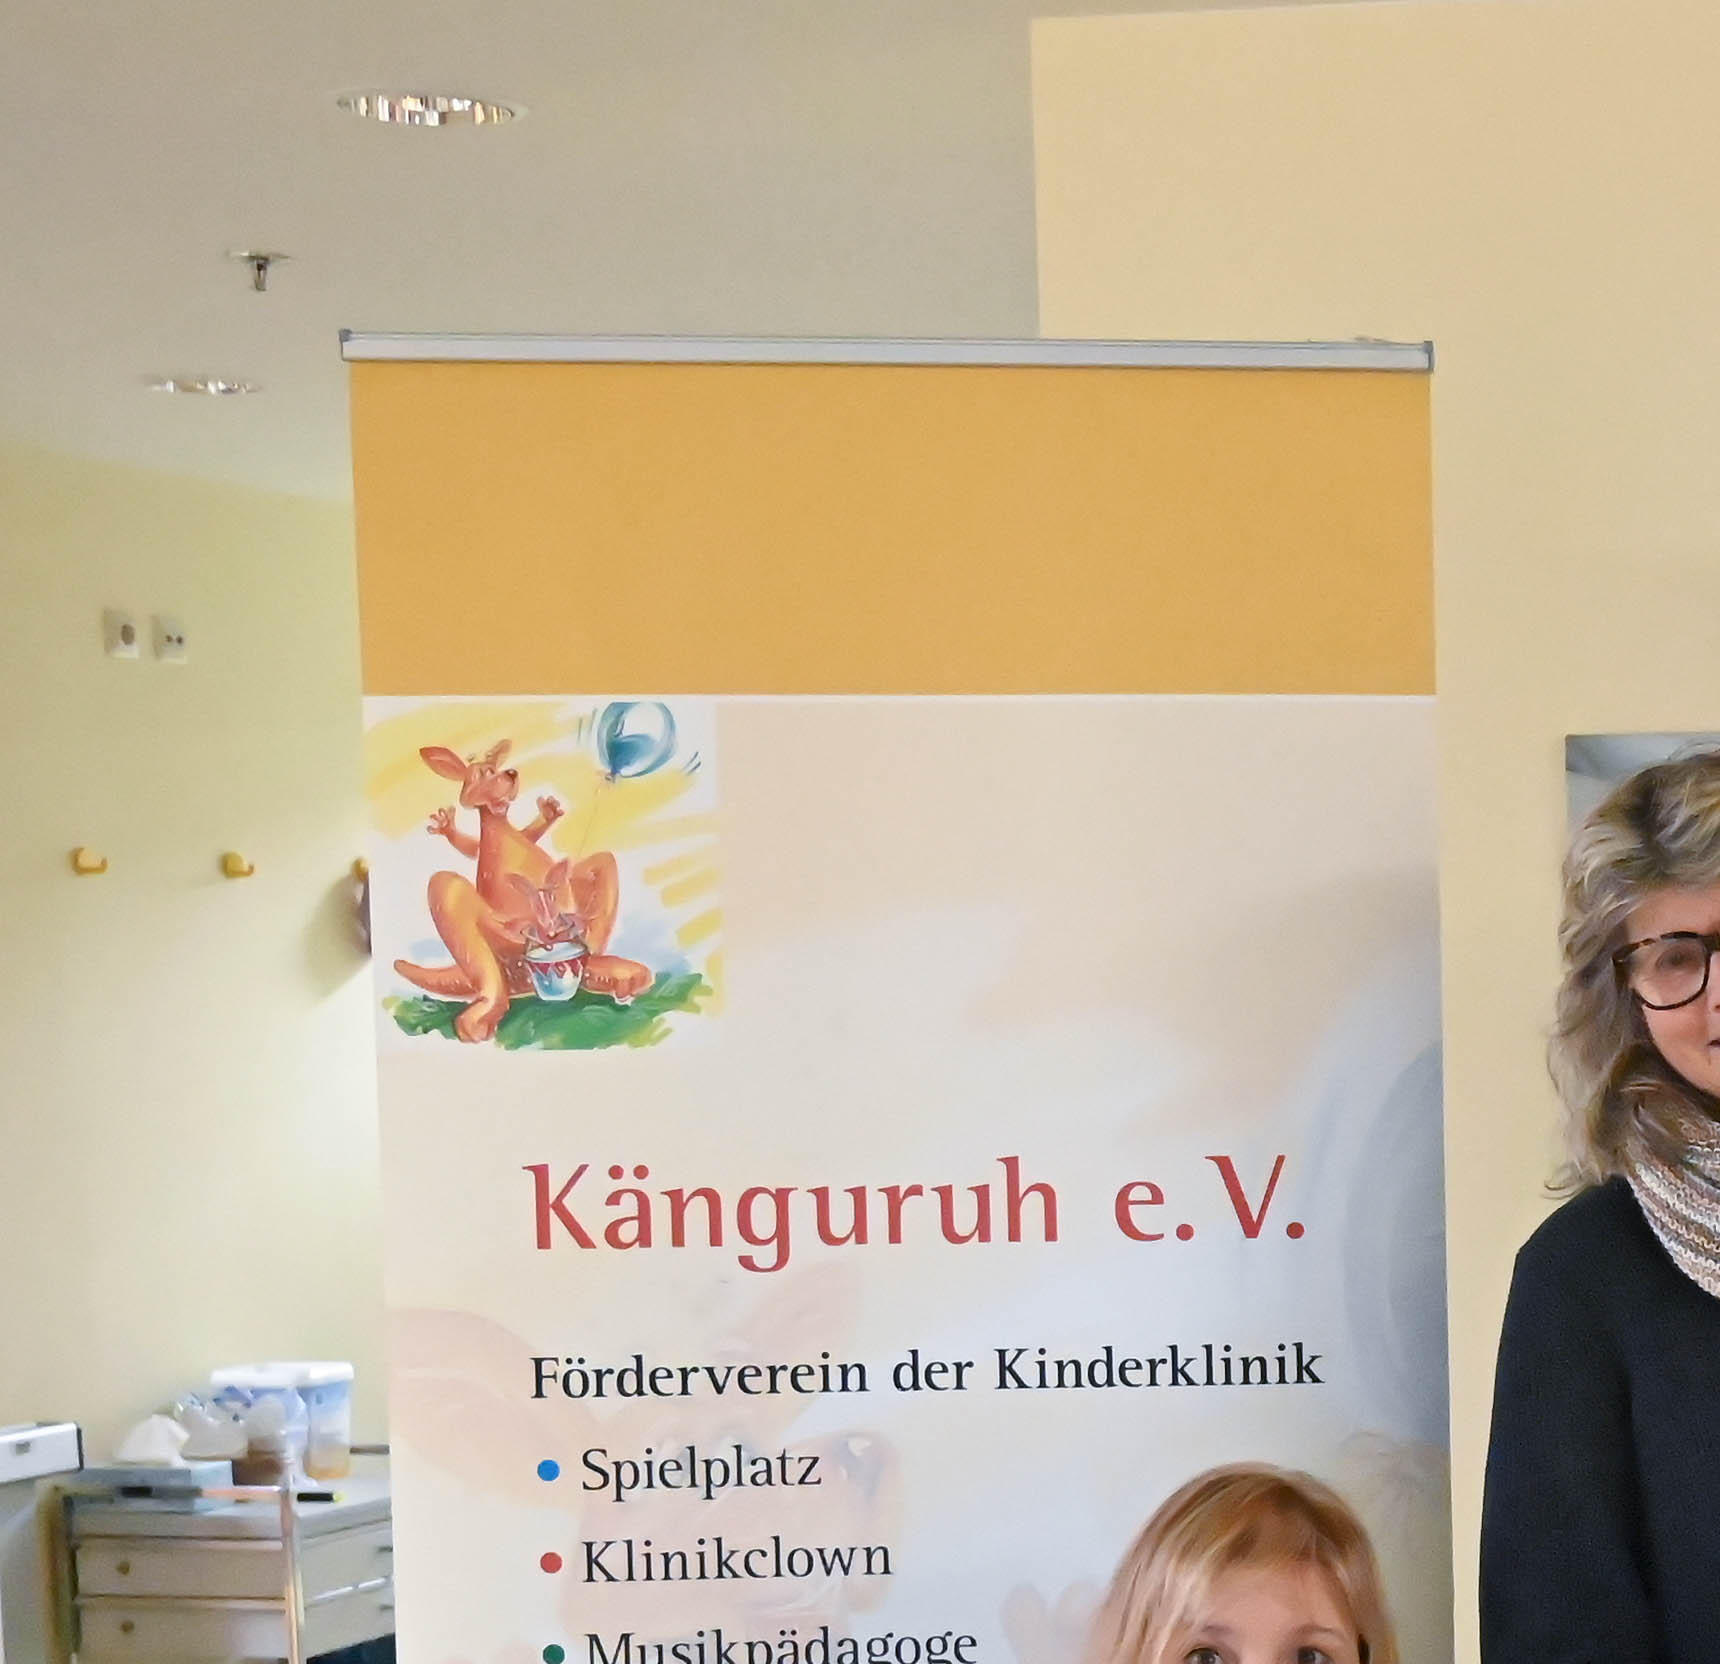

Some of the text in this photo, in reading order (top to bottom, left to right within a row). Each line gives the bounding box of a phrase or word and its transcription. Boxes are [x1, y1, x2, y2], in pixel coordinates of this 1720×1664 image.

[521, 1154, 1306, 1273] Känguruh e.V.
[529, 1341, 1327, 1400] Förderverein der Kinderklinik
[579, 1442, 823, 1503] Spielplatz
[580, 1537, 893, 1585] Klinikclown
